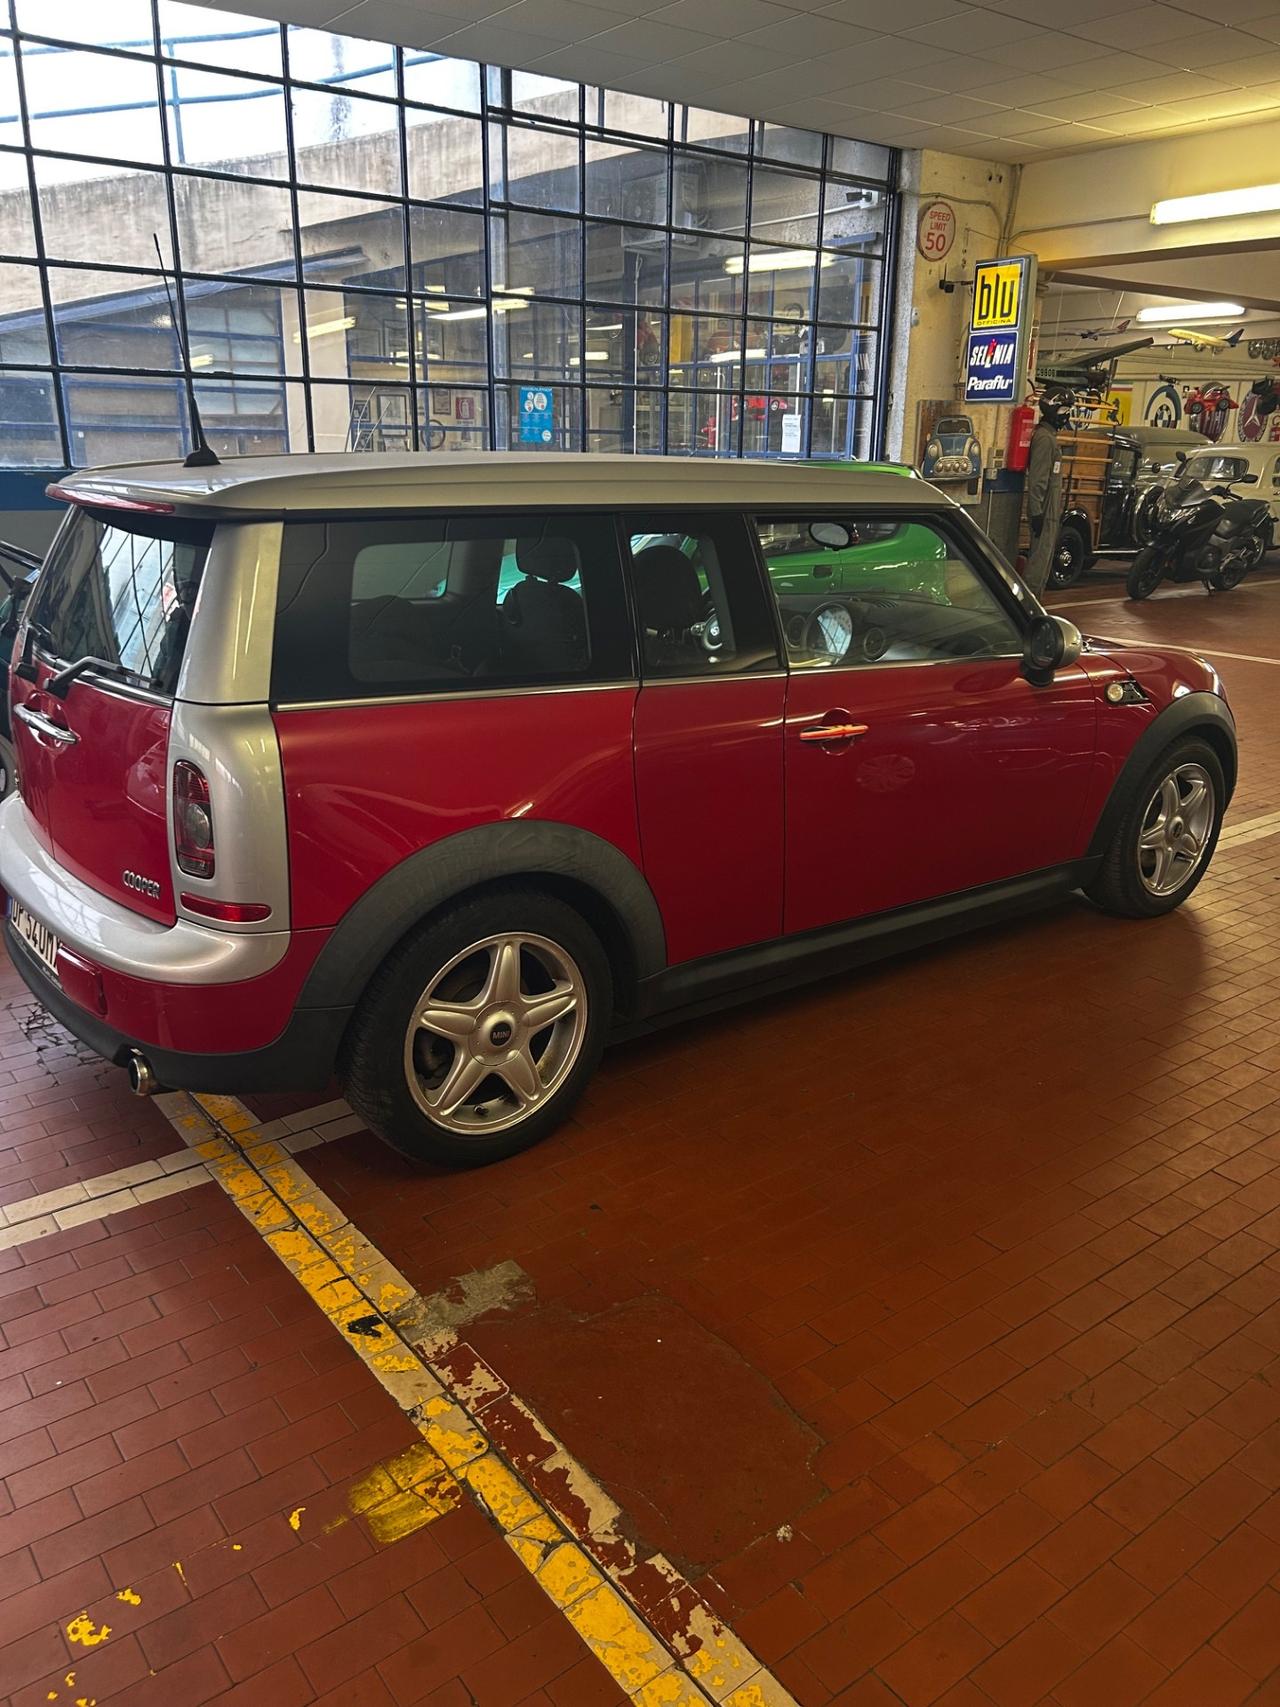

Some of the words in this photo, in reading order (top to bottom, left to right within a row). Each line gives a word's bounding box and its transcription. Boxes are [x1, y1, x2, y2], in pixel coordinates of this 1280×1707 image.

[929, 210, 951, 222] SPEED
[930, 221, 947, 231] LIMIT
[925, 232, 946, 252] 50
[978, 273, 1015, 320] blu
[123, 870, 160, 899] COOPER
[492, 1031, 511, 1039] MINI
